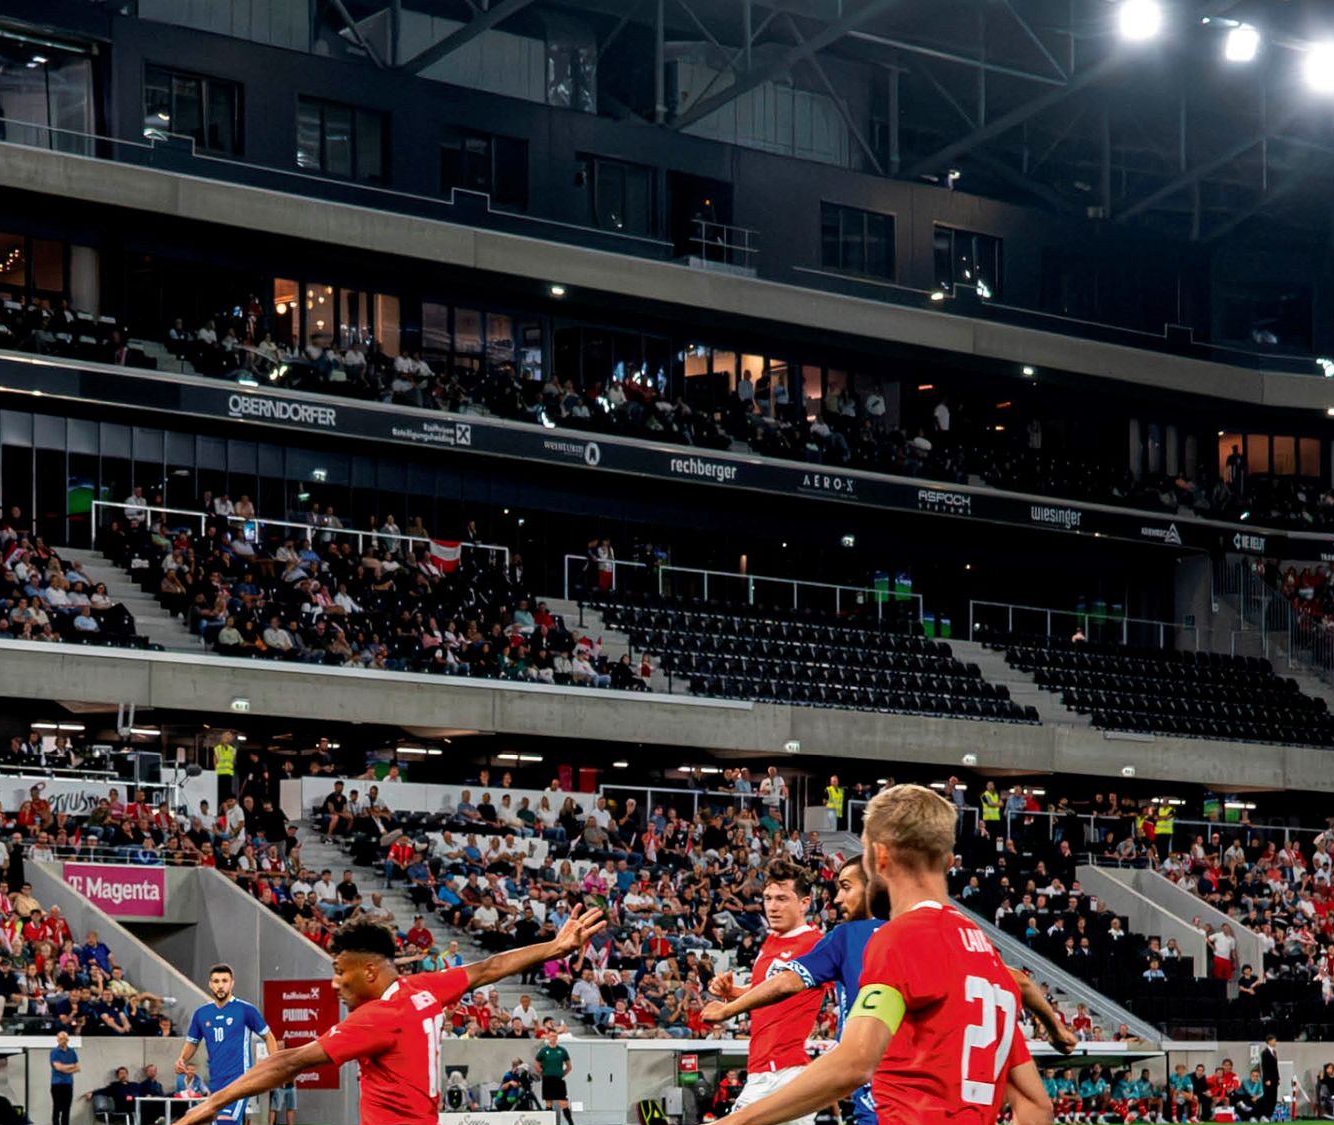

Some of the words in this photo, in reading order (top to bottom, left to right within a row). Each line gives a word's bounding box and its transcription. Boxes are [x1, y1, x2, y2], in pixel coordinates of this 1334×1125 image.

[228, 395, 336, 426] OBERNDORFER
[670, 458, 737, 482] rechberger
[86, 876, 160, 904] Magenta
[862, 990, 882, 1010] C
[213, 1027, 224, 1042] 10
[961, 975, 1016, 1105] 27
